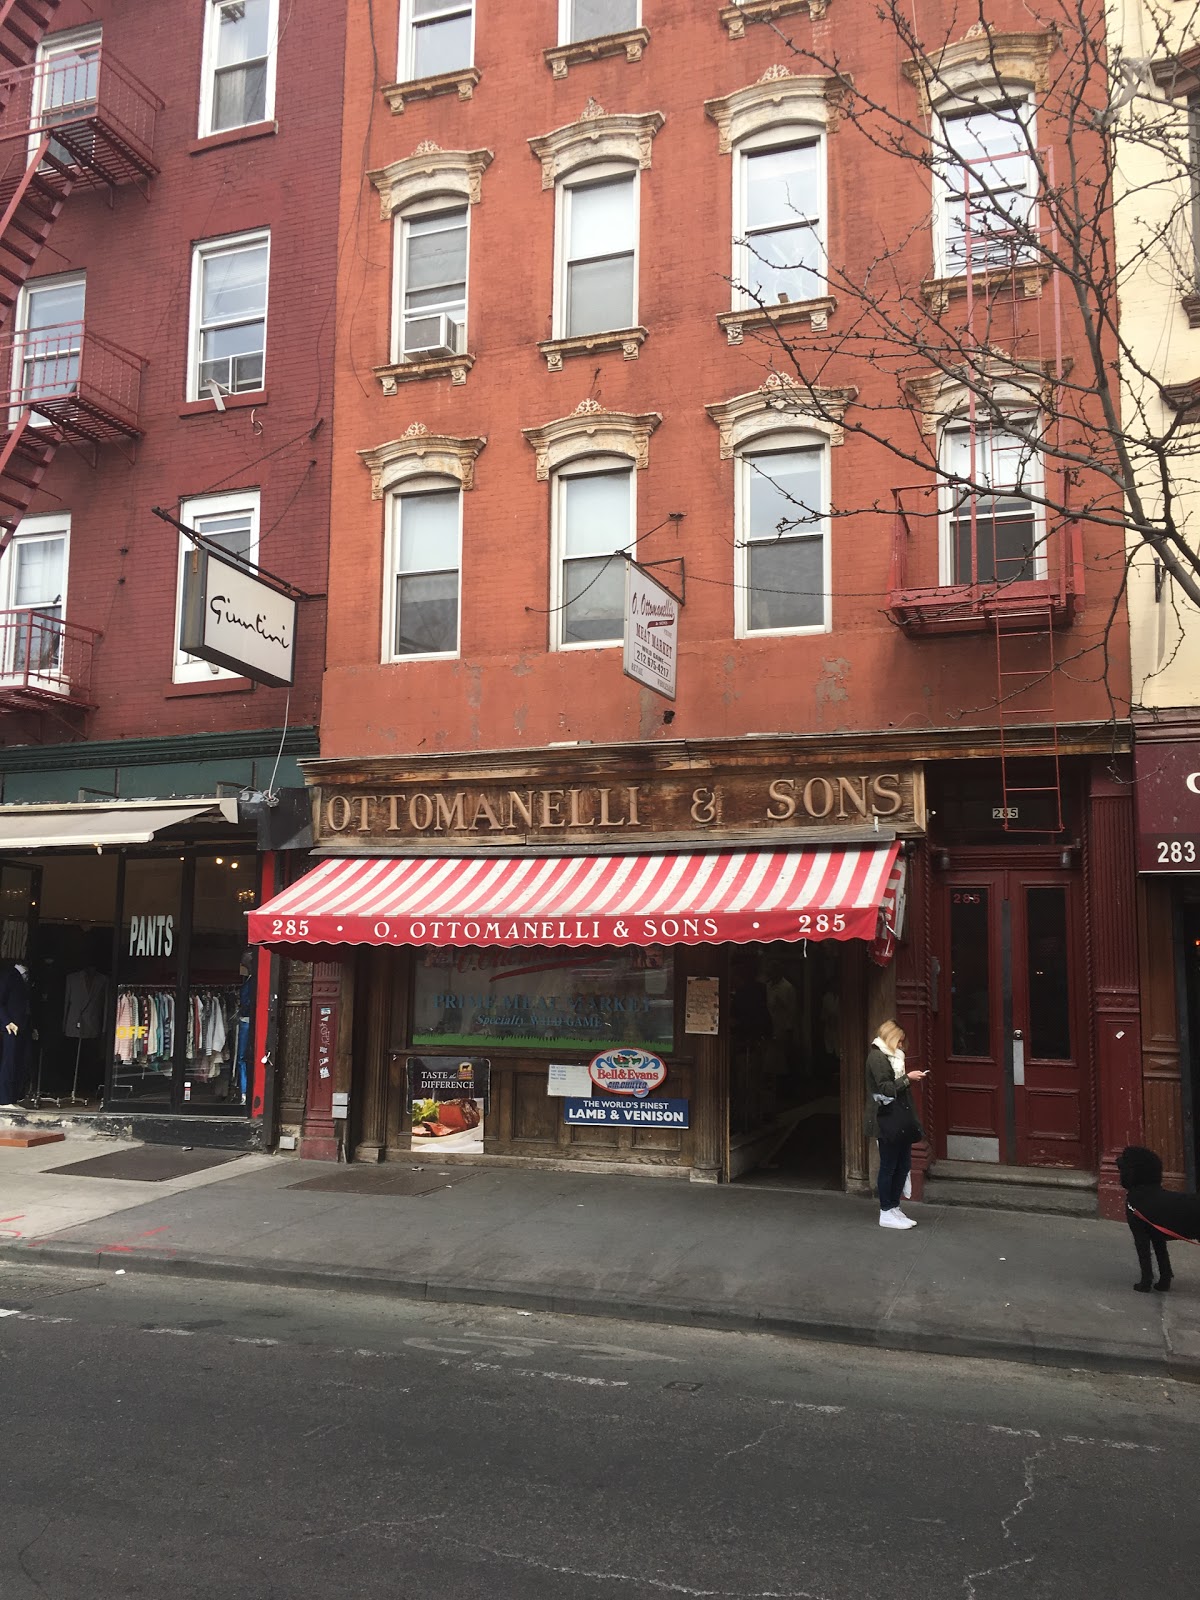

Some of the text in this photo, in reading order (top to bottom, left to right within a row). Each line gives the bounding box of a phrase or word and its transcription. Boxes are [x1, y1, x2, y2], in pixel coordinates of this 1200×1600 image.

[210, 595, 290, 649] Giuntini
[636, 622, 673, 659] MEAT MARKET
[636, 649, 670, 678] 212 675-4217
[327, 773, 903, 832] OTTOMANELLI & SONS
[993, 808, 1017, 817] 285
[1156, 840, 1197, 863] 283
[952, 893, 981, 904] 285
[271, 913, 846, 939] 285 O. OTTOMANELLI & SONS 285
[129, 914, 174, 957] PANTS
[432, 993, 653, 1013] PRIME MEAT MARKET
[475, 1014, 525, 1027] Specialty
[565, 1014, 603, 1028] GAME
[115, 1025, 149, 1039] OFF
[420, 1071, 448, 1079] TASTE
[420, 1080, 475, 1089] DIFFERENCE
[583, 1100, 669, 1110] THE WORLD'S FINEST
[568, 1108, 684, 1122] LAMB & VENISON
